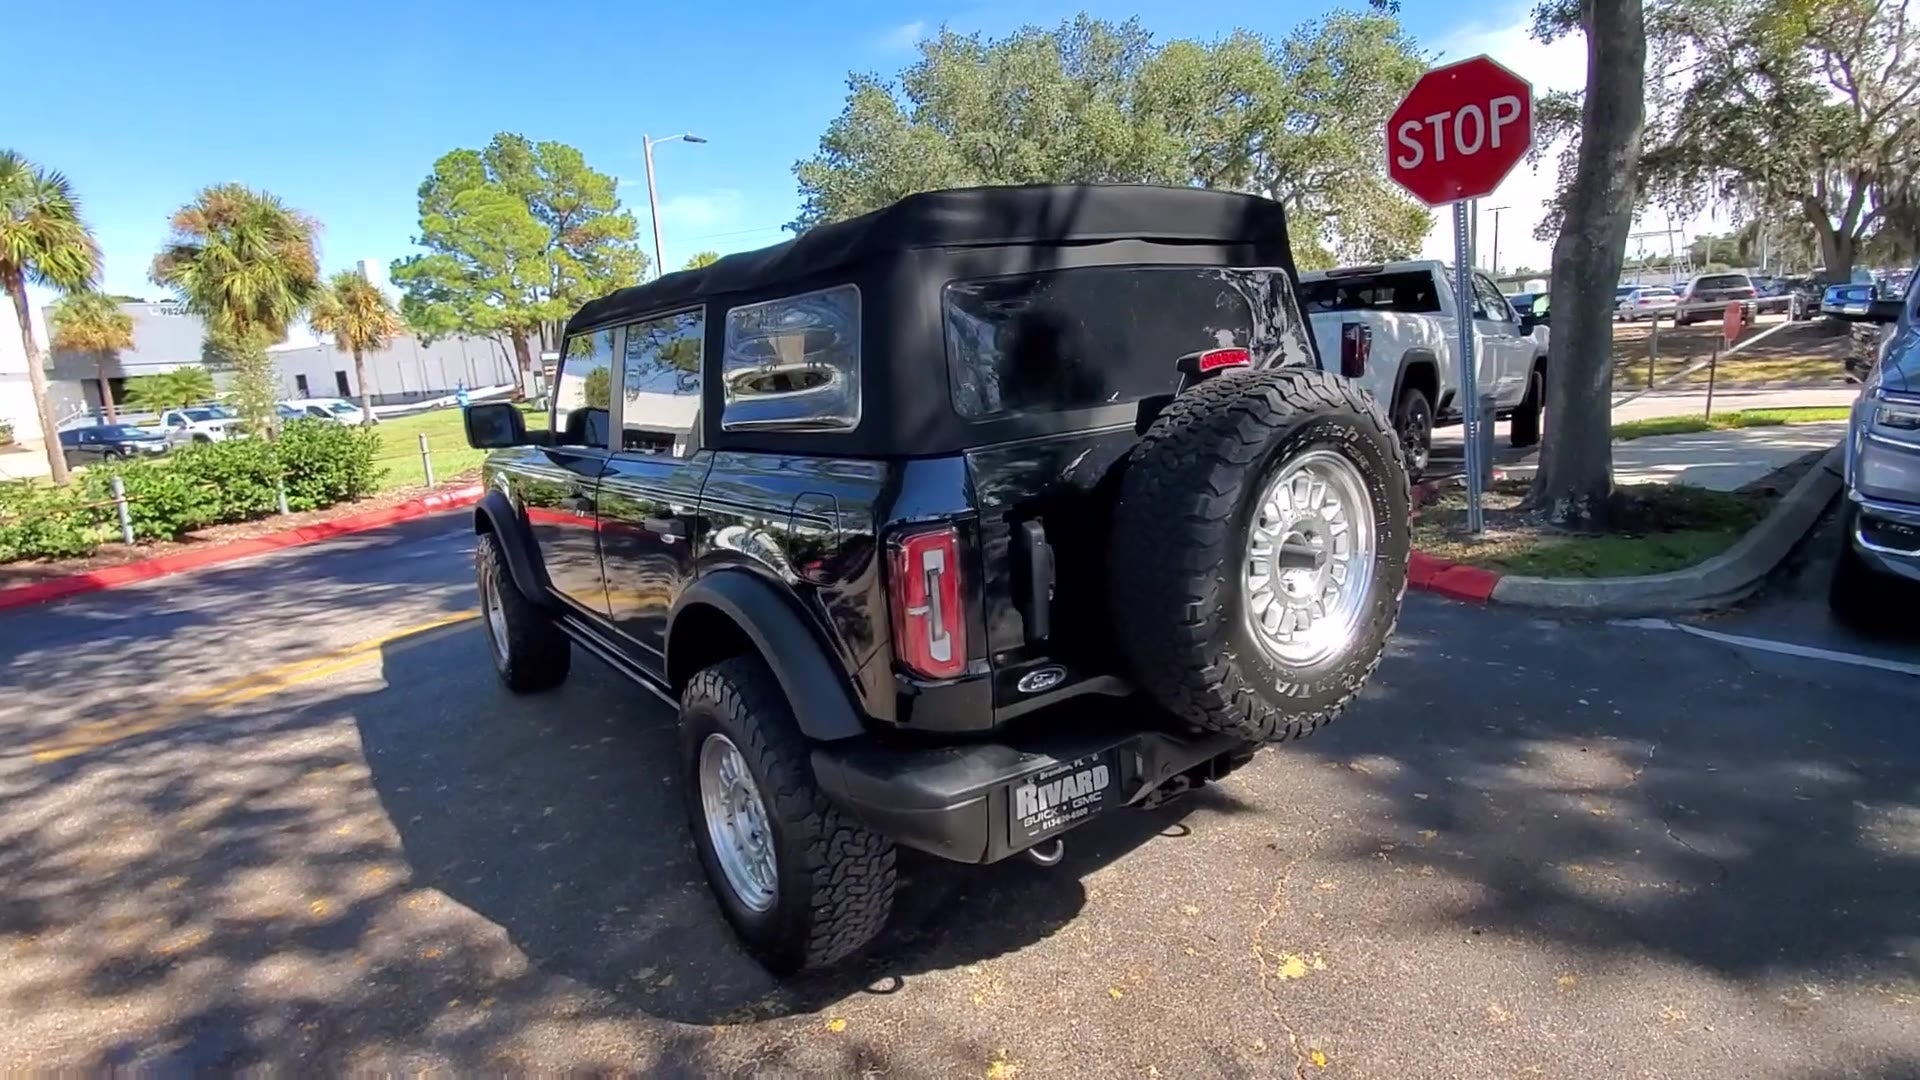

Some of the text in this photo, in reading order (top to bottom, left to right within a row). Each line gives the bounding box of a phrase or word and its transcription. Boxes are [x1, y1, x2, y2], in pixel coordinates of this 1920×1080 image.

[1397, 95, 1521, 169] STOP
[1016, 764, 1110, 821] RIVARD
[1024, 791, 1102, 828] BUICK GMC
